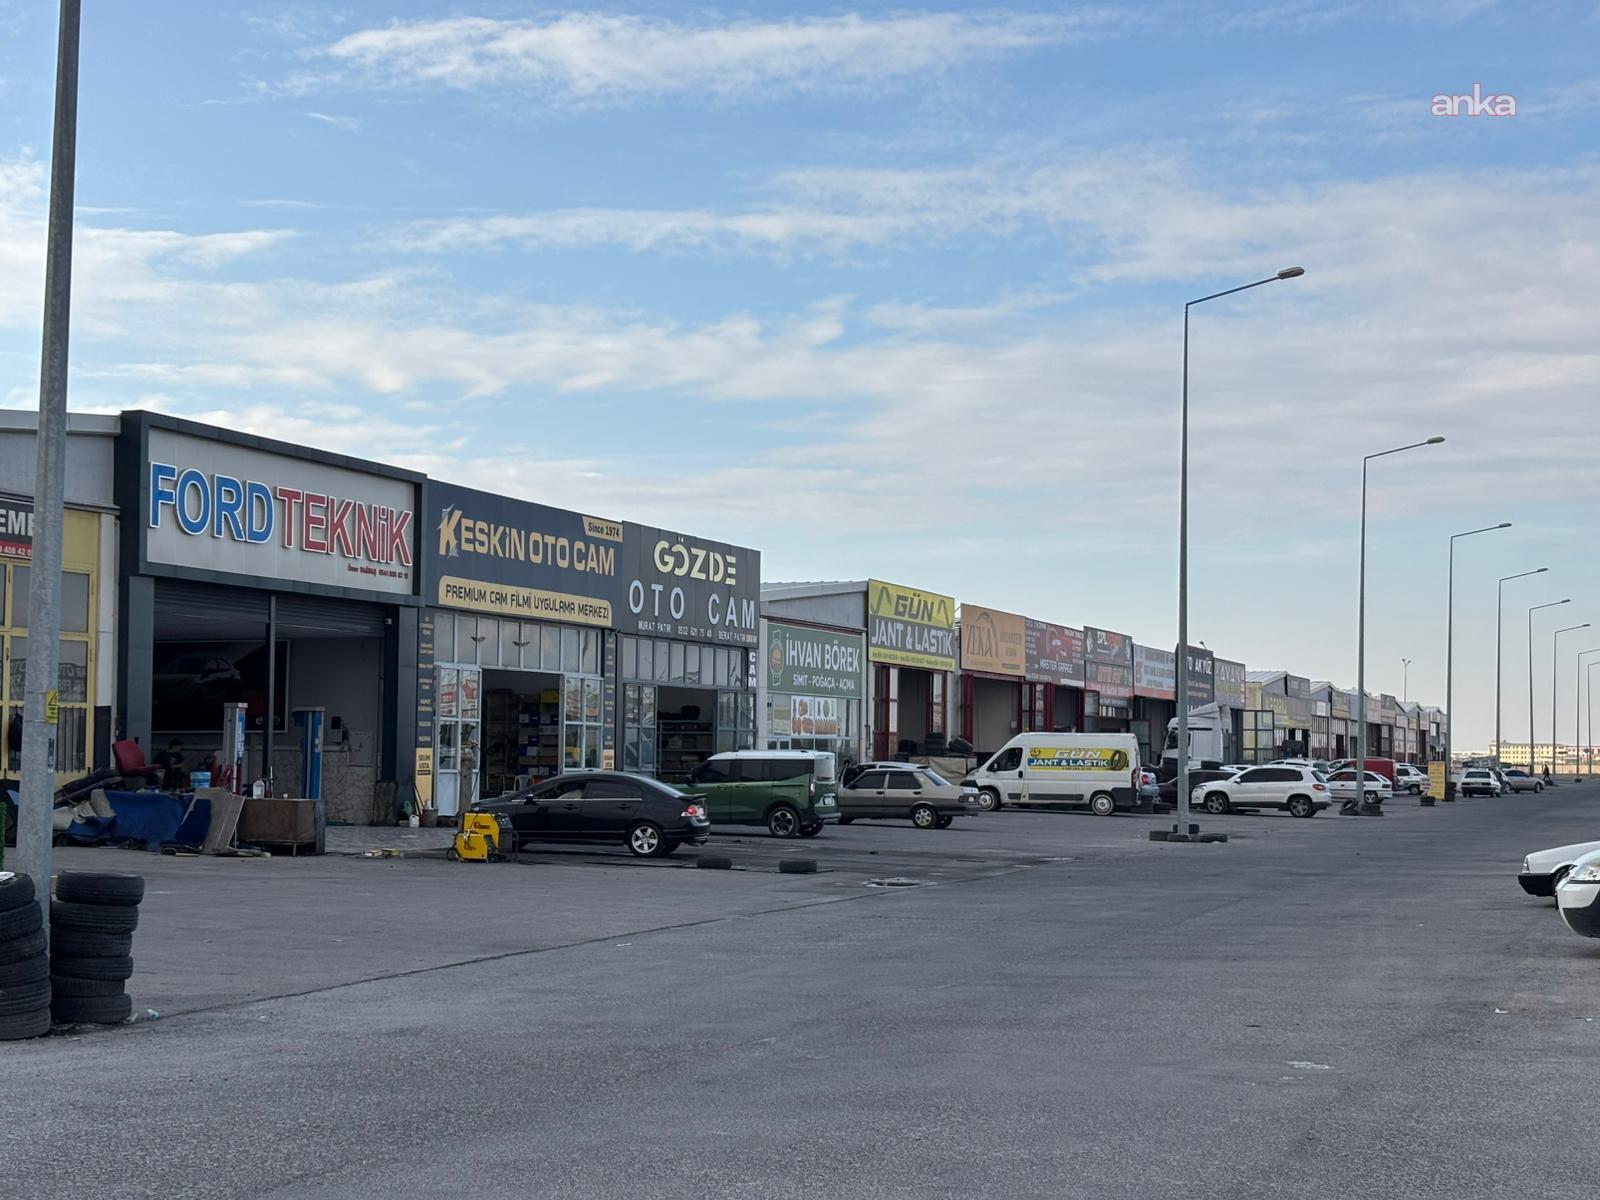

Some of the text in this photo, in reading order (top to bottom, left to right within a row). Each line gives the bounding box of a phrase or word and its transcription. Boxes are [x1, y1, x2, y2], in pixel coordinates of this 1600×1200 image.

[149, 462, 275, 543] FORD
[588, 521, 620, 538] Since 1974
[529, 532, 570, 569] OTO
[573, 541, 615, 577] CAM
[653, 537, 736, 586] GÖZDE
[489, 590, 508, 606] CAM
[533, 595, 576, 614] UYGULAMA
[629, 579, 755, 629] OTO CAM
[895, 592, 934, 622] GÜN
[871, 619, 904, 648] JANT
[905, 626, 913, 650] &
[785, 633, 822, 669] İHVAN
[824, 640, 860, 673] BÖREK
[812, 674, 836, 691] POĞAÇA
[839, 679, 855, 692] AÇMA
